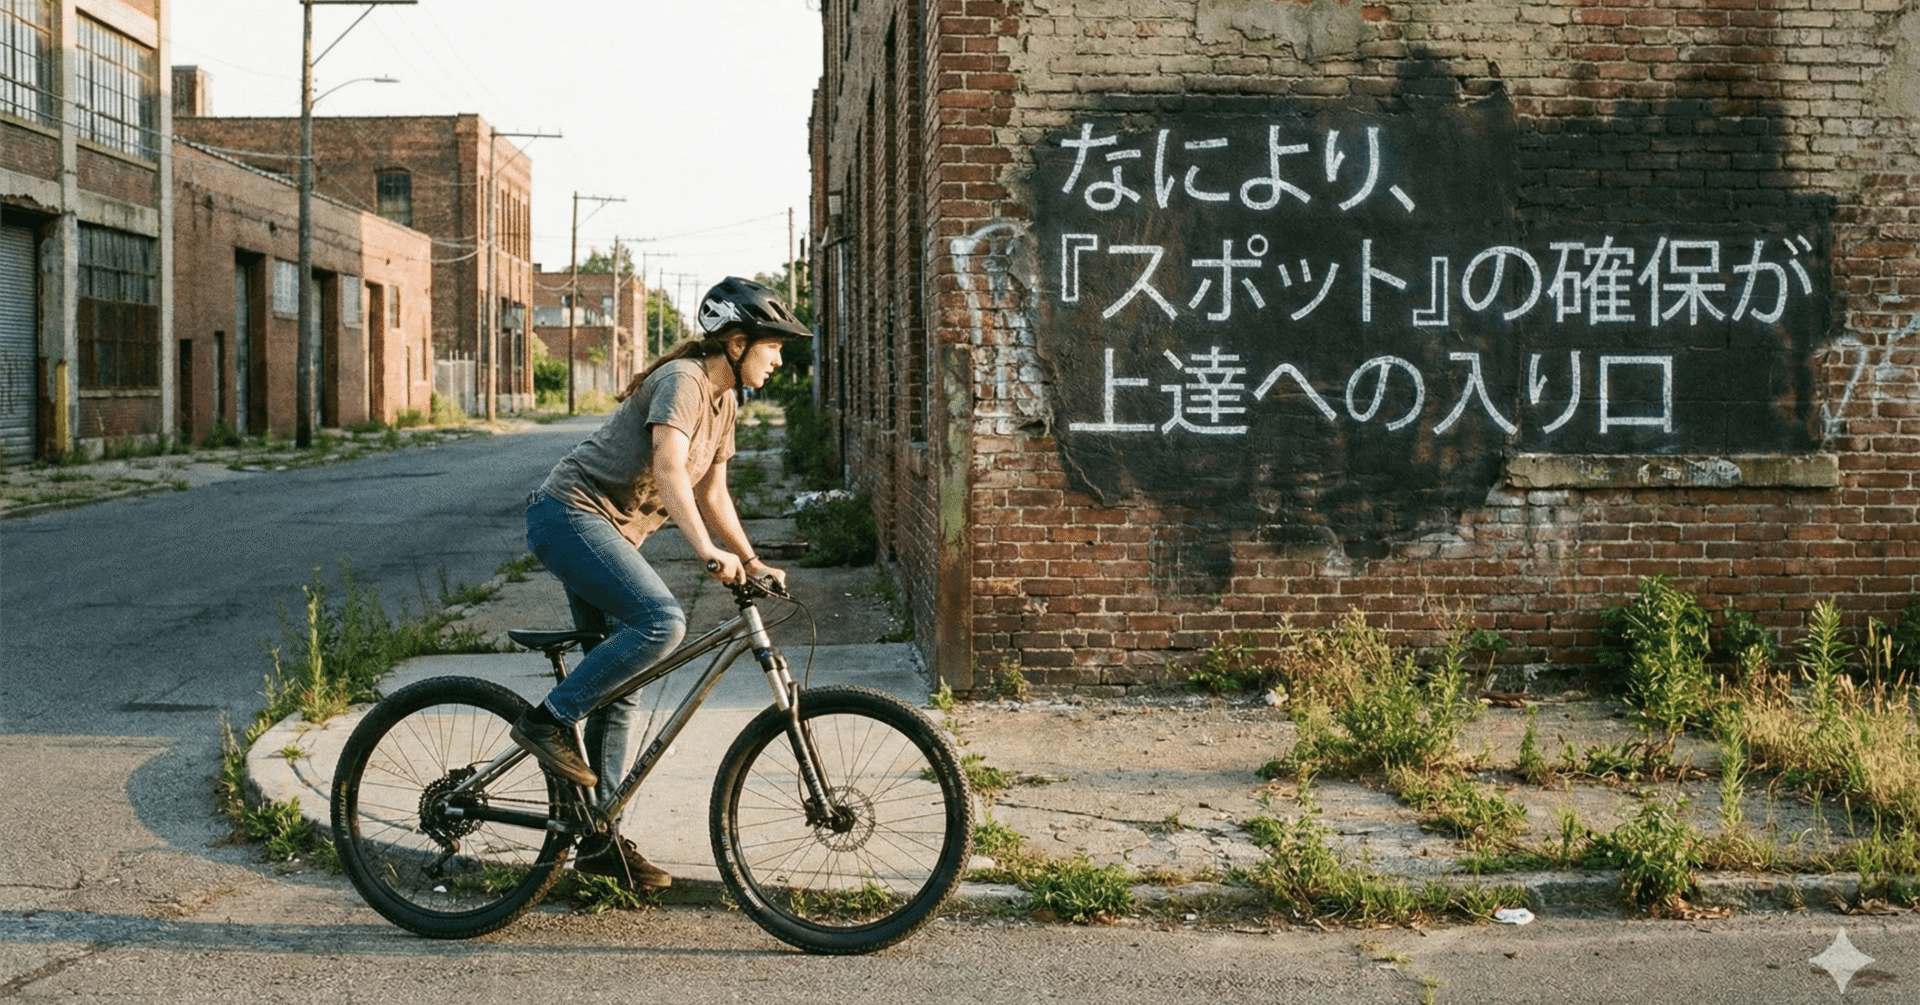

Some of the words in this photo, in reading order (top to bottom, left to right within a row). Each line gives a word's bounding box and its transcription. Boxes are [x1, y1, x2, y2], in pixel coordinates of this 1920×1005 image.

[1060, 122, 1415, 212] なにより、
[1060, 233, 1813, 327] 『スポット』の確保が
[1068, 347, 1674, 436] 上達への入り口
